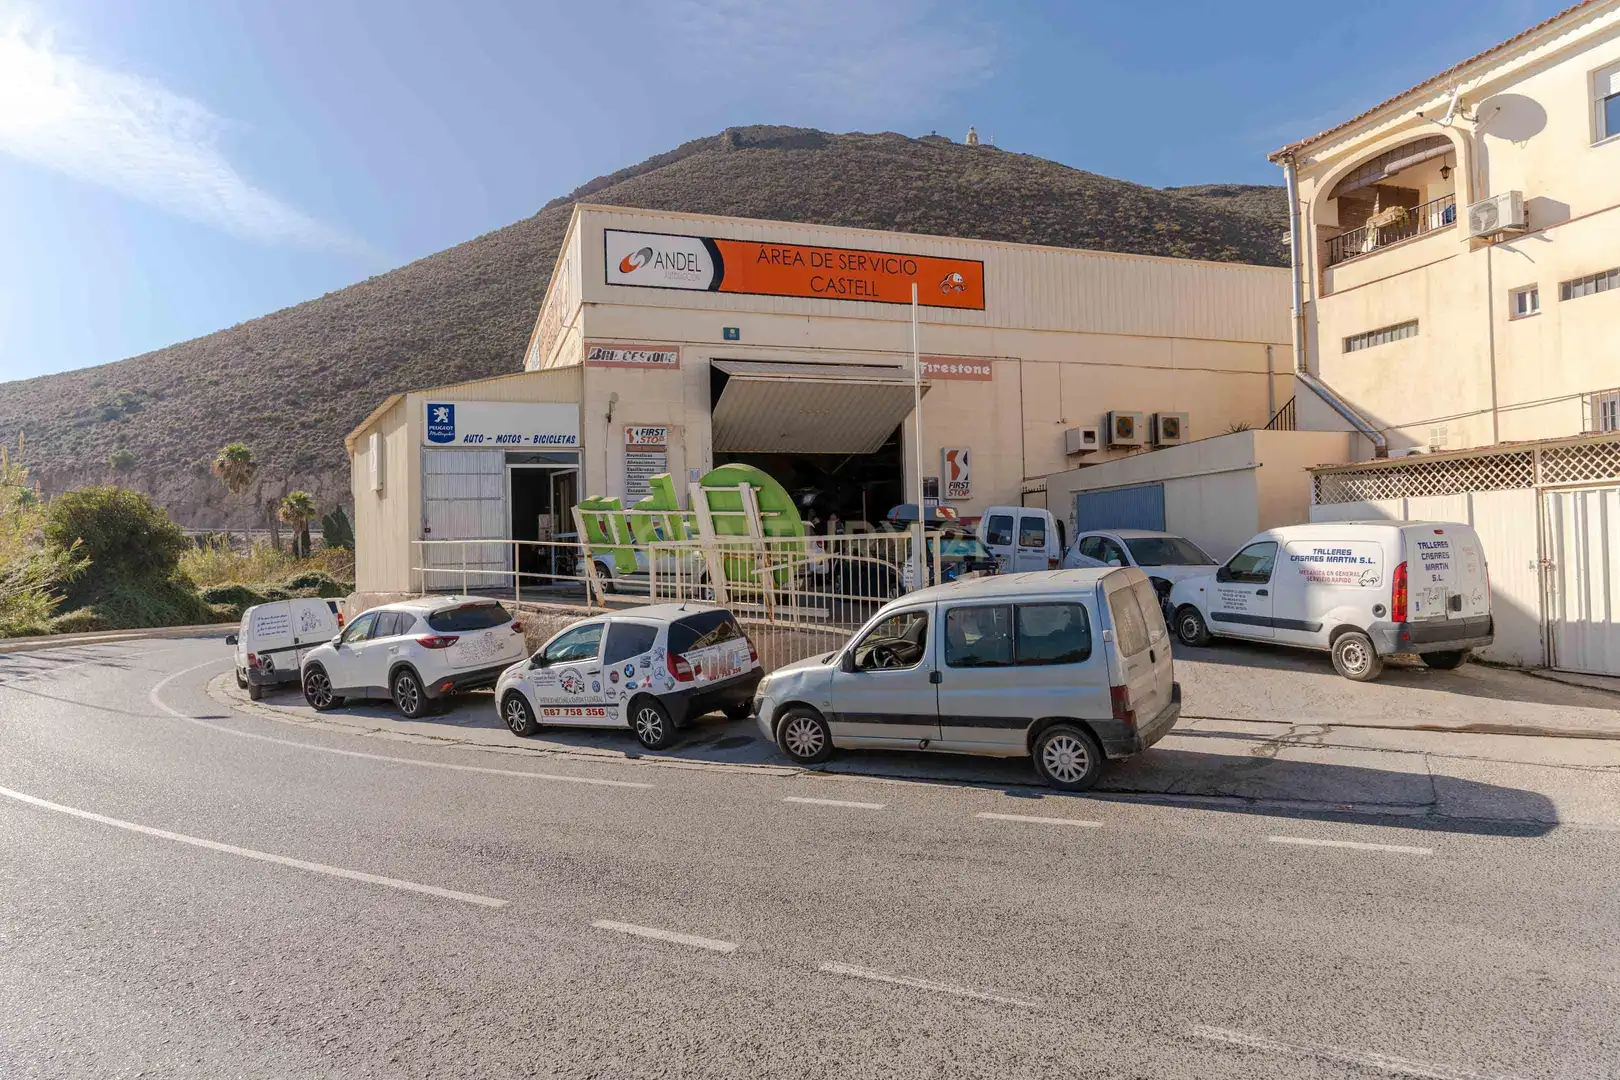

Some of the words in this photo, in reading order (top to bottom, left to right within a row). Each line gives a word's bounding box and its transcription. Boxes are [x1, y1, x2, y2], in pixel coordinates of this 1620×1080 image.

[654, 251, 702, 273] ANDEL
[757, 244, 806, 266] ÁREA
[811, 251, 833, 269] DE
[838, 253, 918, 276] SERVICIO
[810, 275, 880, 297] CASTELL
[919, 361, 991, 375] Firestone
[640, 428, 666, 436] FIRST
[463, 434, 484, 444] AUTO
[495, 434, 522, 444] MOTOS
[533, 434, 576, 444] BICICLETAS
[948, 481, 970, 489] FIRST
[948, 489, 970, 497] STOP
[1417, 540, 1449, 550] TALLERES
[1312, 548, 1352, 556] TALLERES
[1421, 551, 1450, 561] CASARES
[1326, 556, 1357, 564] MARTIN
[1425, 562, 1449, 571] MARTIN
[543, 708, 561, 716] 687
[563, 708, 583, 716] 758
[585, 708, 605, 716] 356
